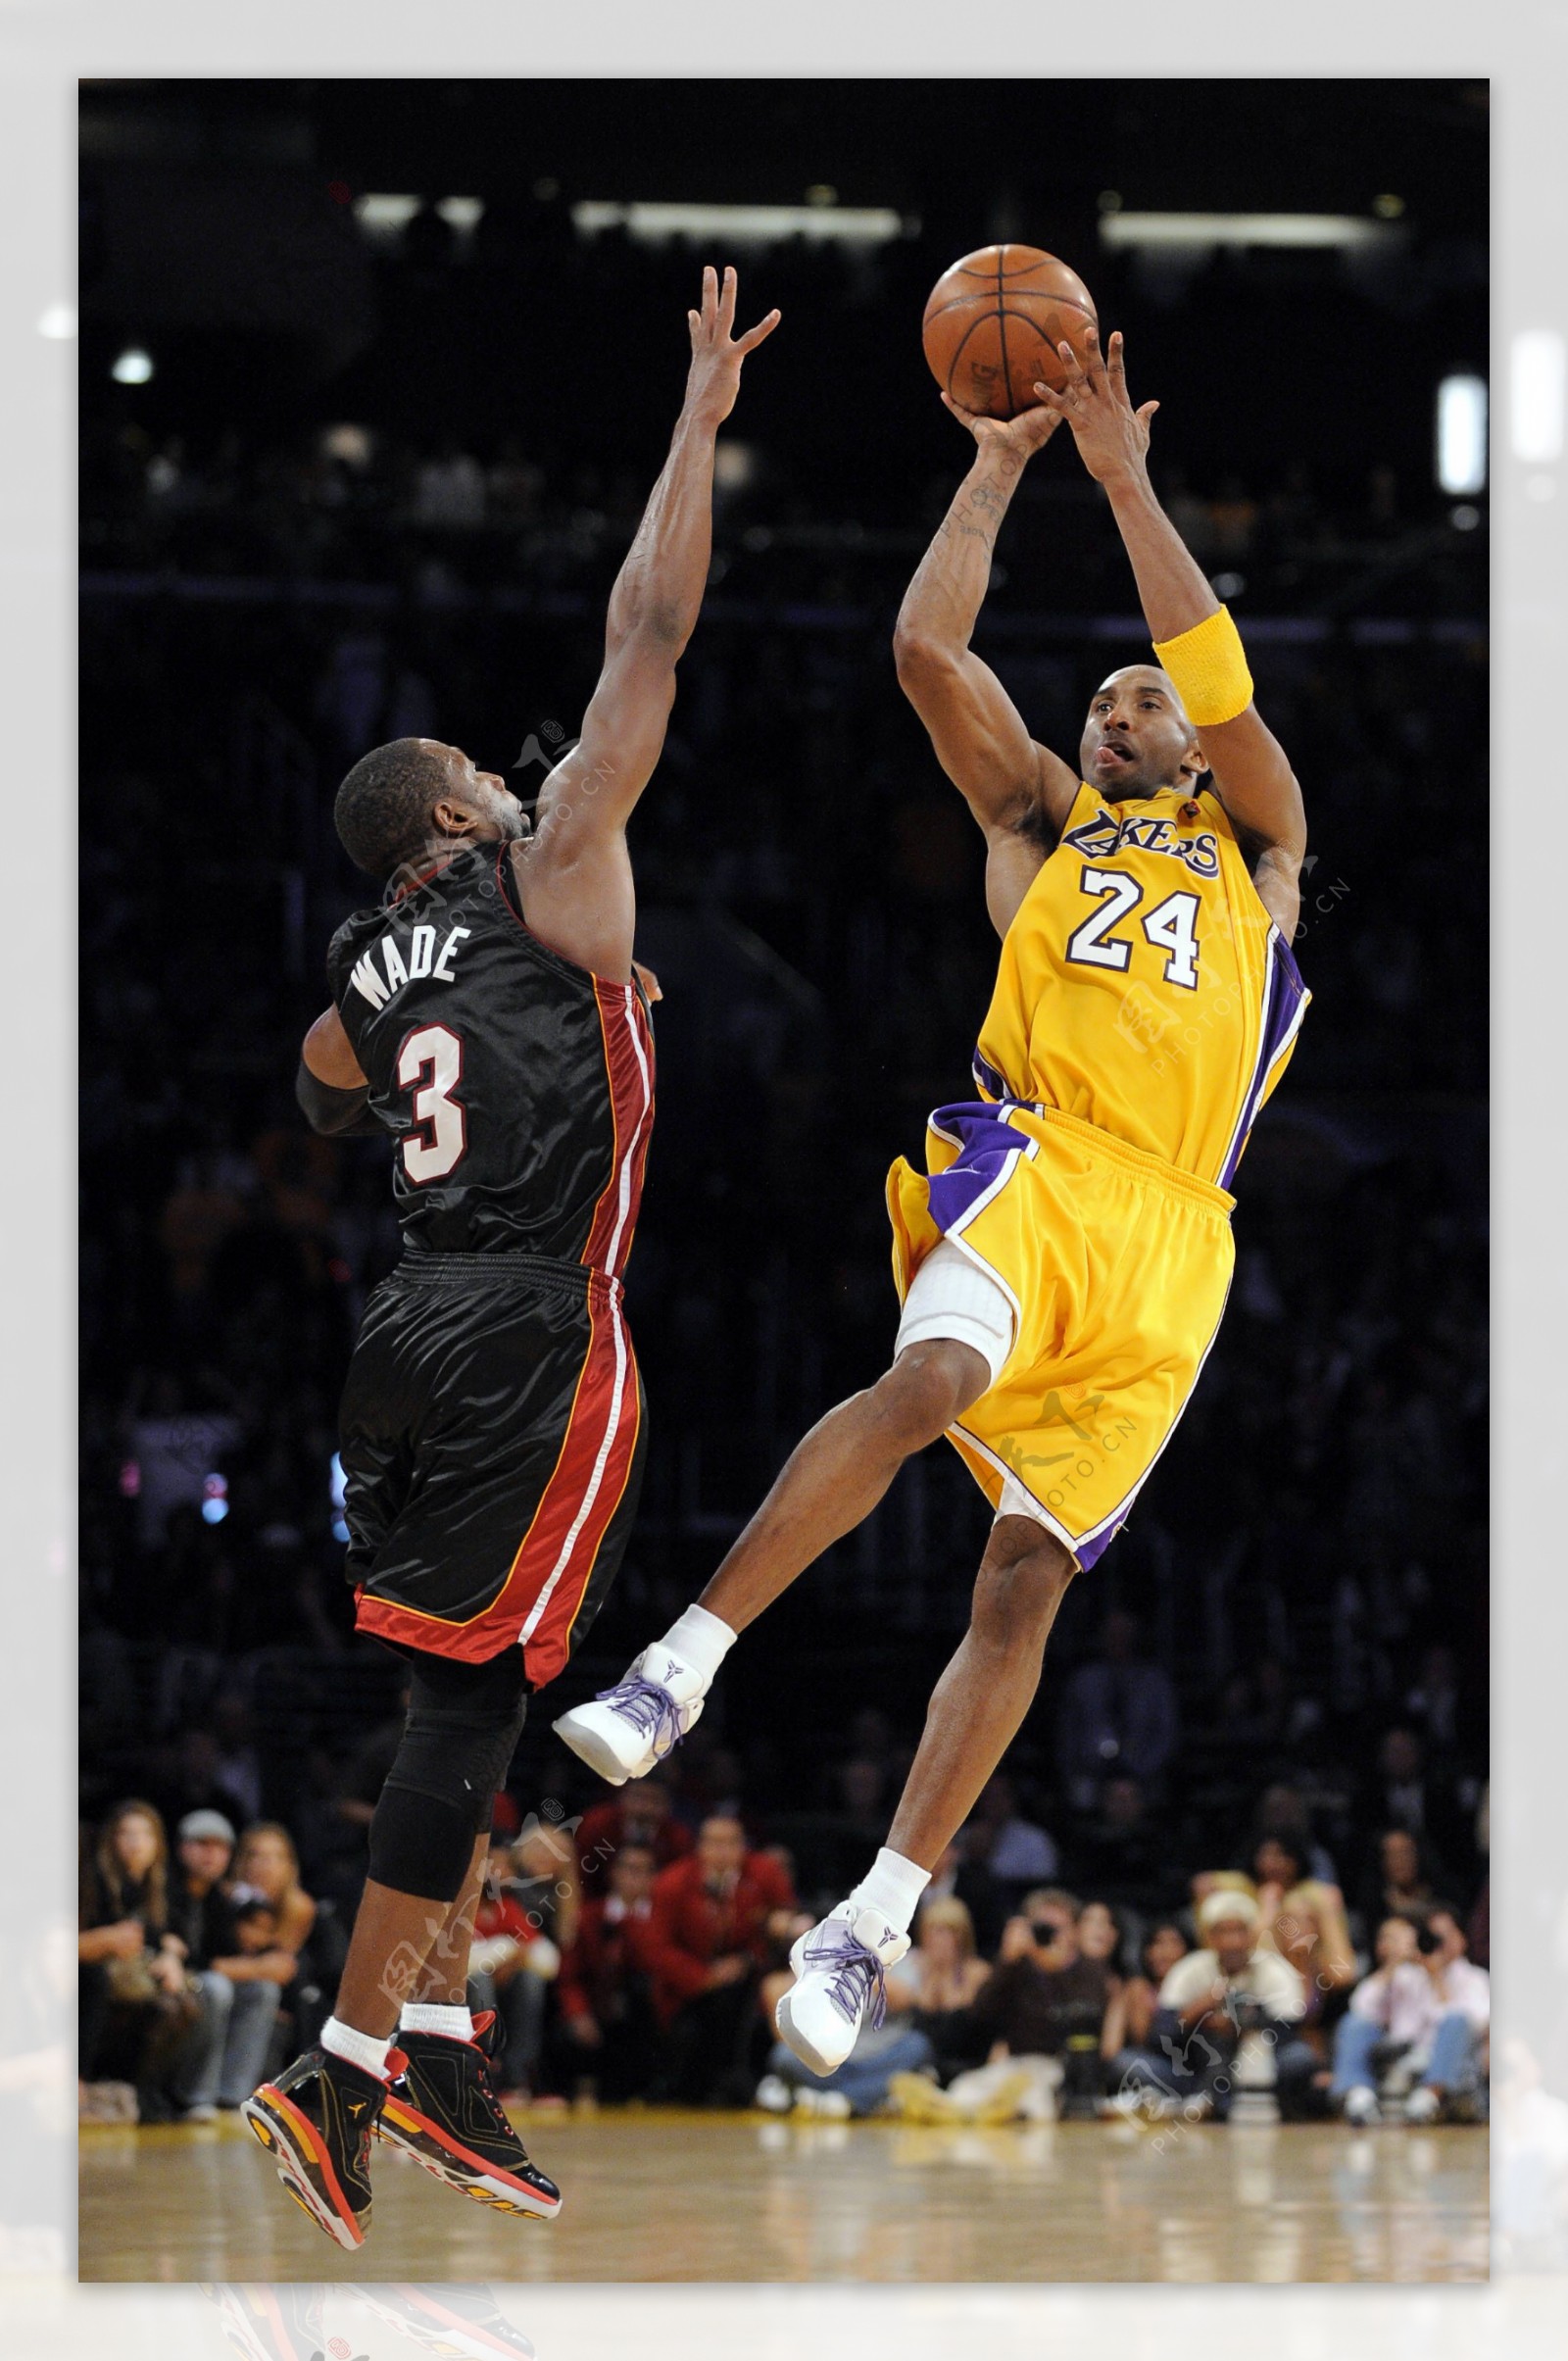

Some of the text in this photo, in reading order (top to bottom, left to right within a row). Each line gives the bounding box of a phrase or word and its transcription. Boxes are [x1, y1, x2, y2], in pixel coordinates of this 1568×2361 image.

[350, 924, 471, 1011] WADE
[1065, 864, 1201, 992] 24
[397, 1020, 467, 1187] 3
